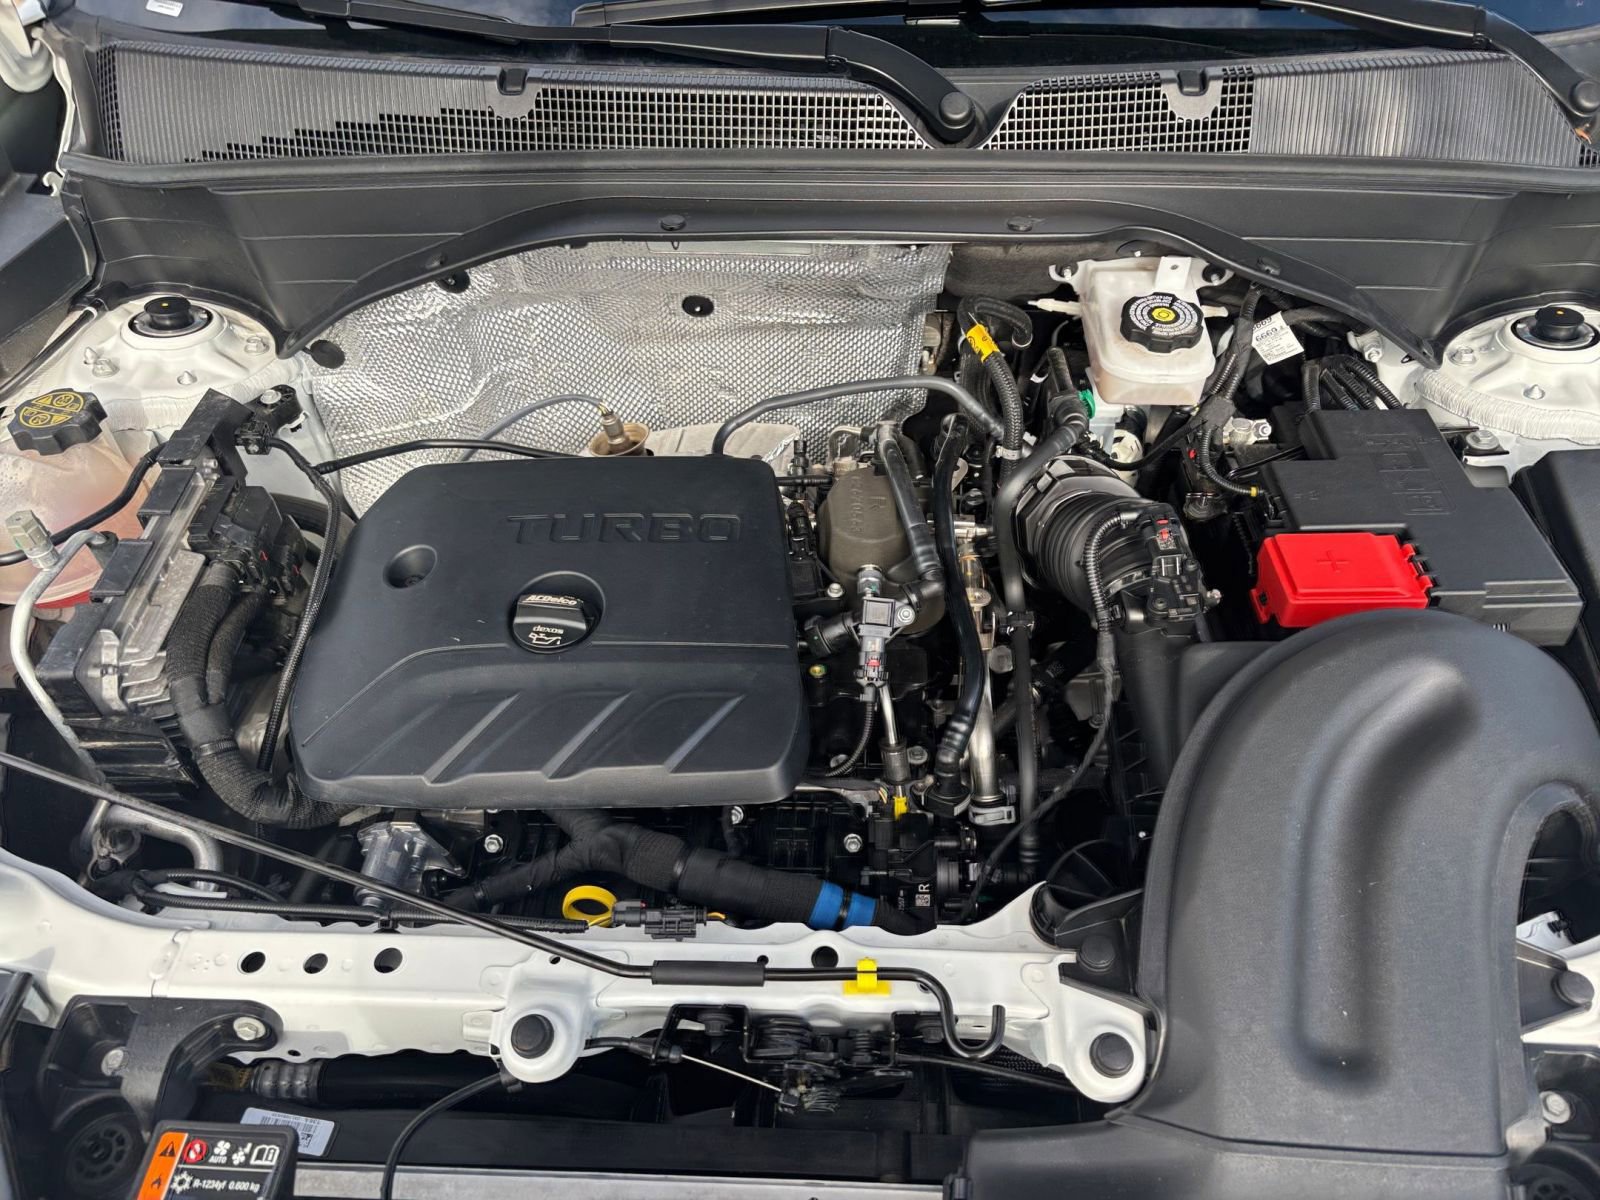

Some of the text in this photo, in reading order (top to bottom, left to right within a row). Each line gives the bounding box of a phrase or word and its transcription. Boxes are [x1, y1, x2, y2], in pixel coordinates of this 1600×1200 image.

[507, 512, 741, 545] TURBO
[525, 594, 578, 606] ACDelco
[532, 624, 565, 635] dexos
[208, 1155, 228, 1164] AUTO
[192, 1178, 227, 1192] R-1234yf
[250, 1181, 261, 1193] kg
